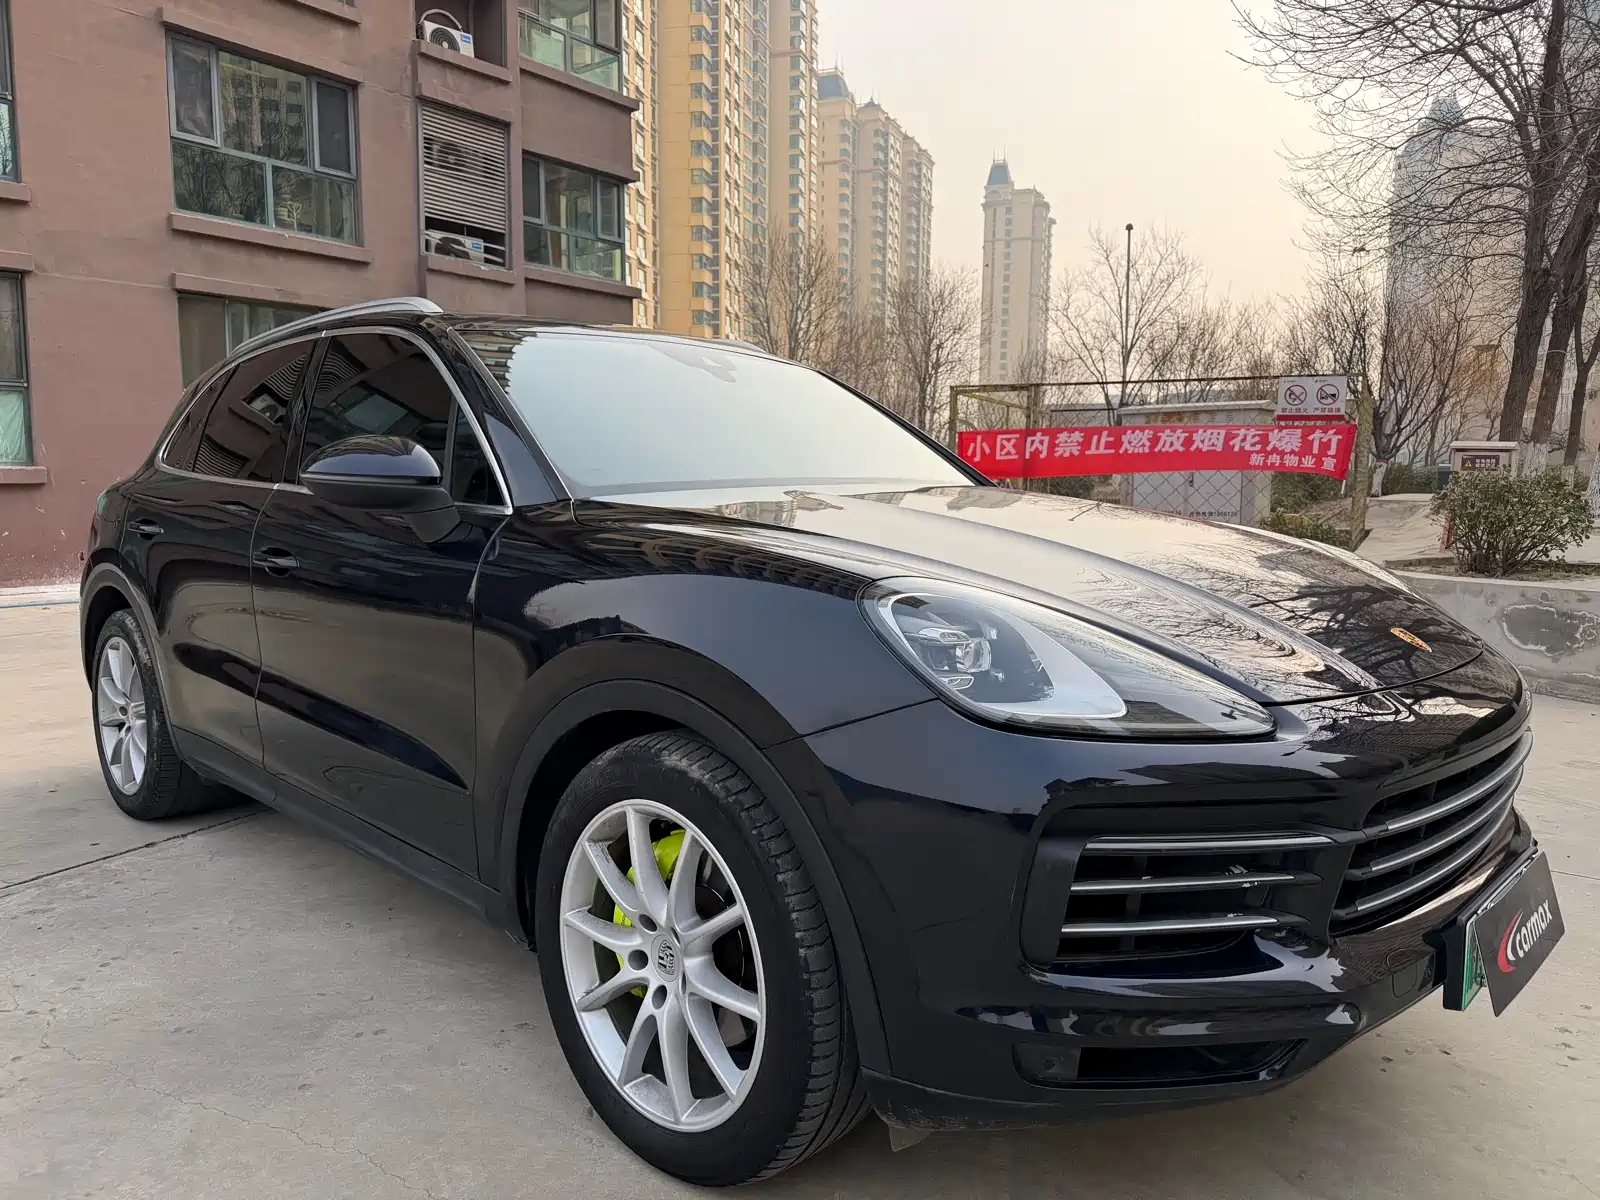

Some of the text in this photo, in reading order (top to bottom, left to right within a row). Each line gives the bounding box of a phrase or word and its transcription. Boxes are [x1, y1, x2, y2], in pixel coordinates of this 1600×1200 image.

[967, 428, 1343, 462] 小区内禁止燃放烟花爆竹
[1249, 453, 1337, 471] 新冉物业 宣
[1515, 899, 1553, 958] carmax
